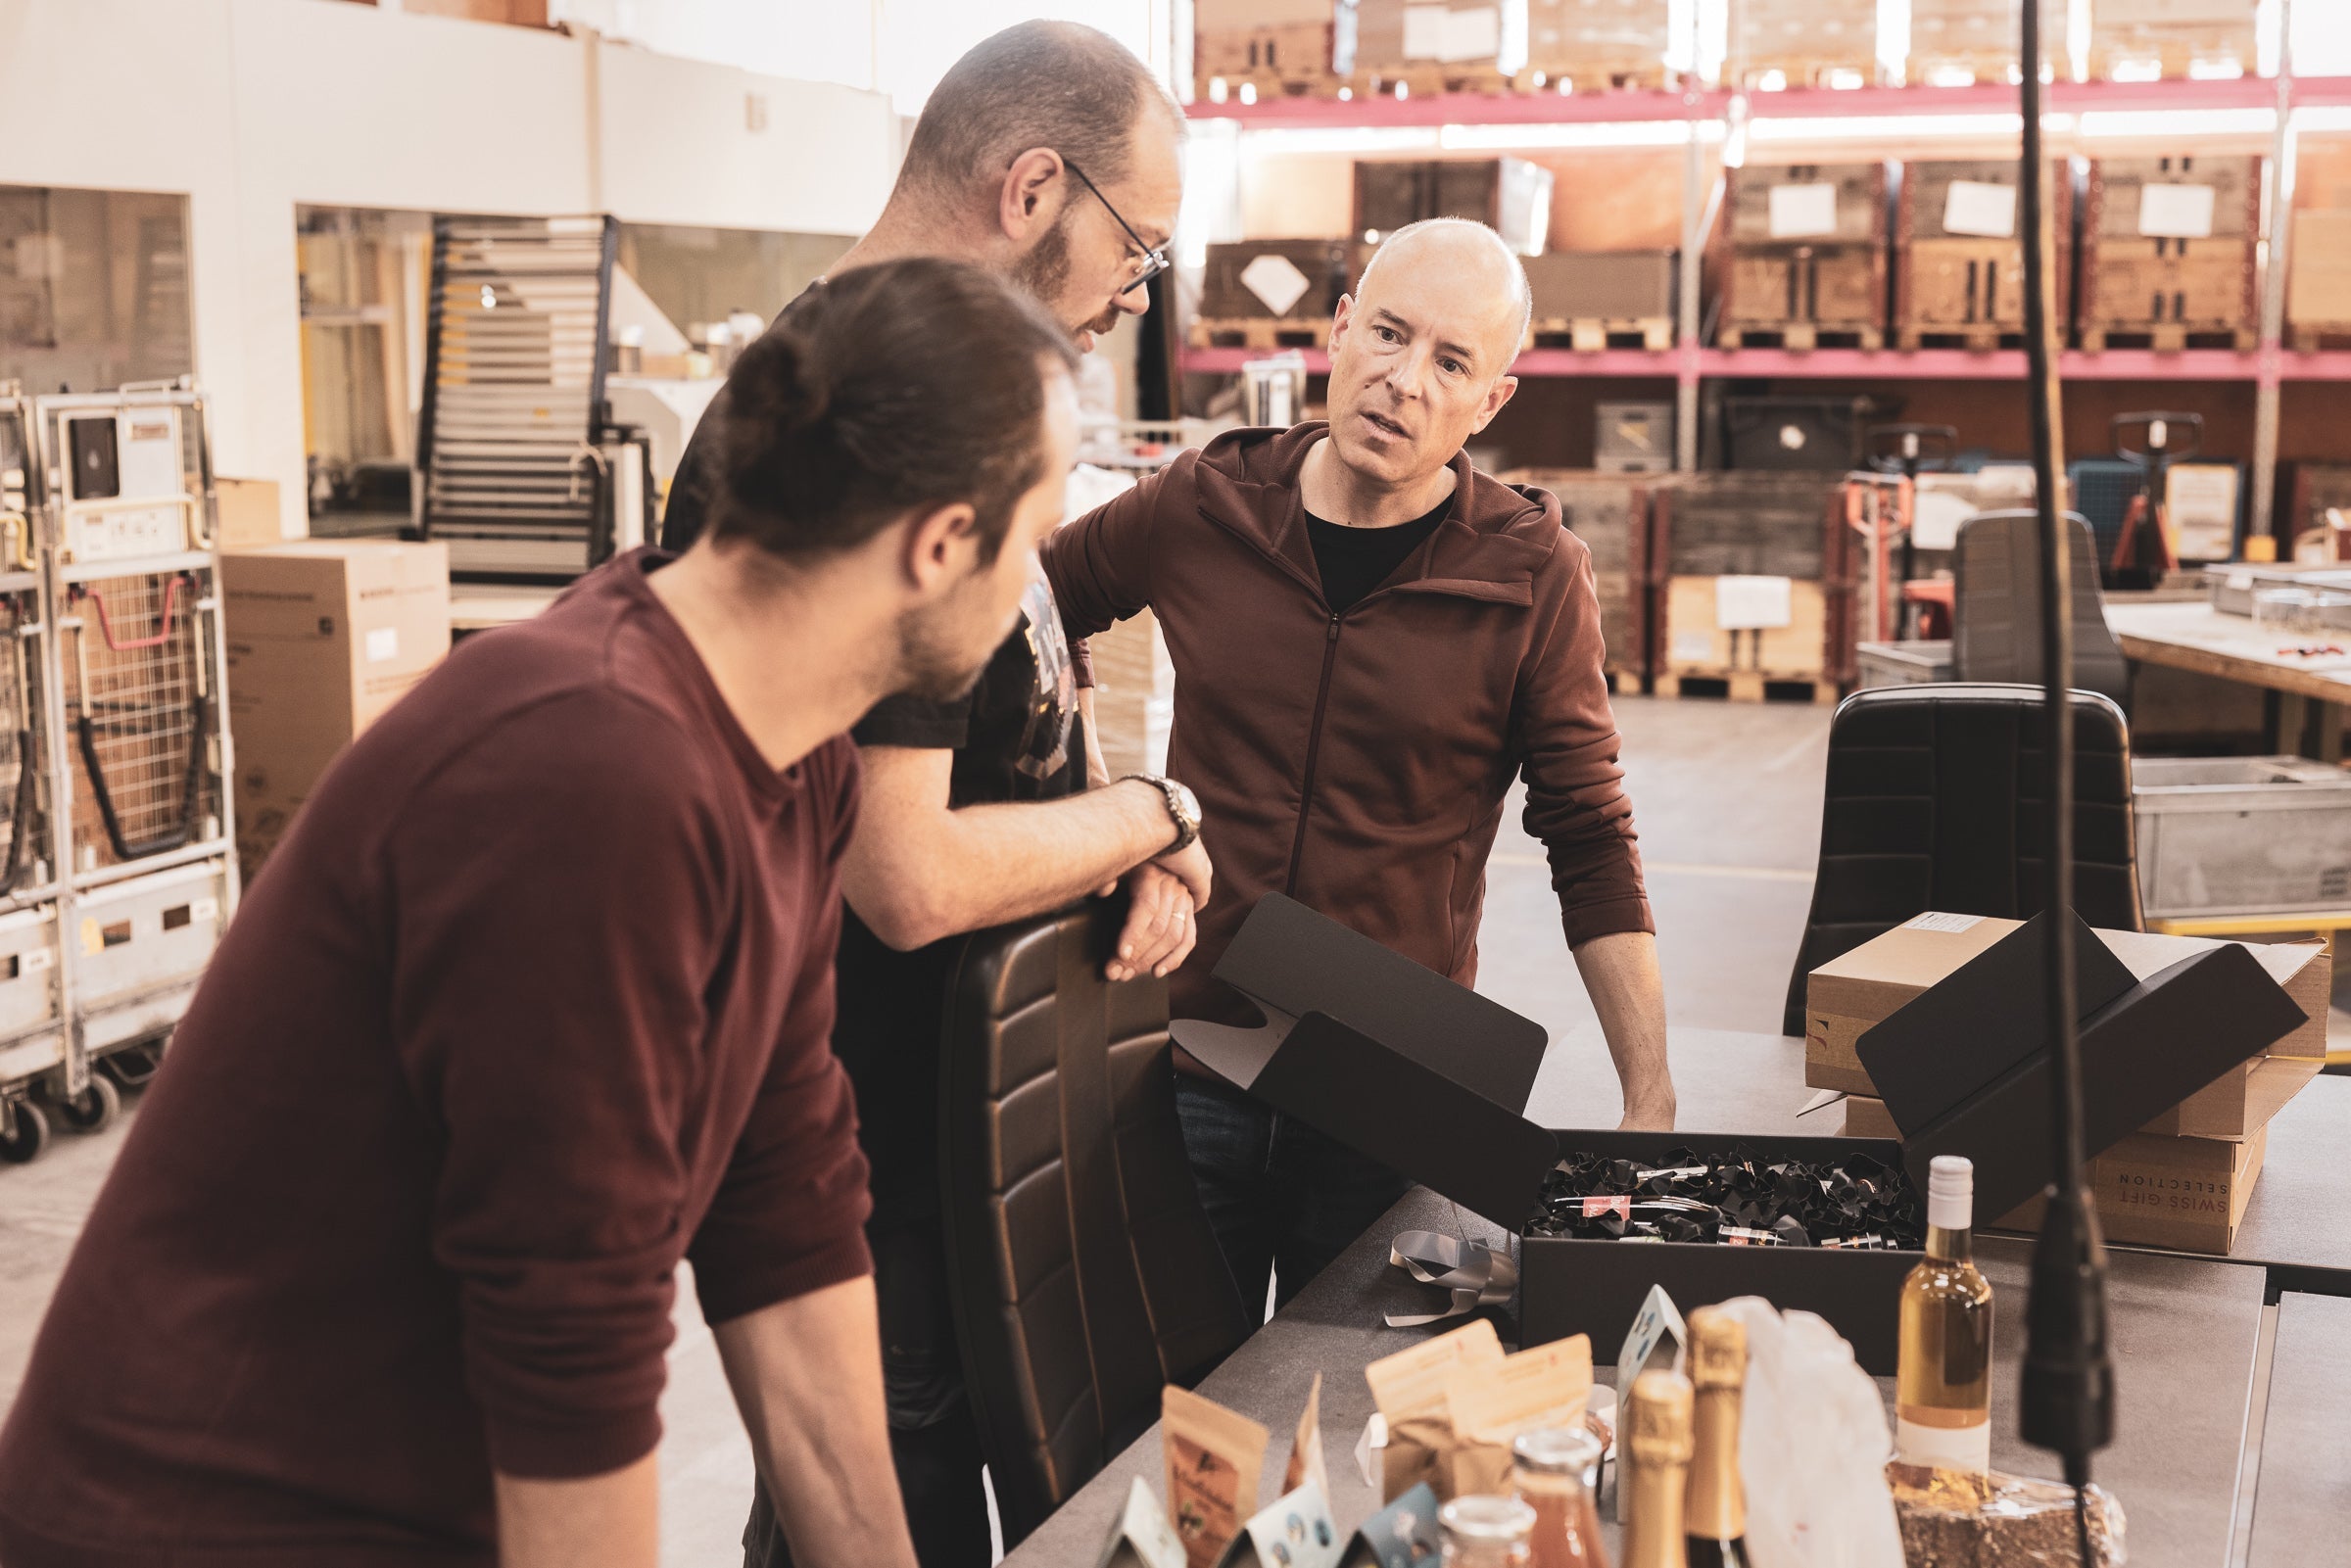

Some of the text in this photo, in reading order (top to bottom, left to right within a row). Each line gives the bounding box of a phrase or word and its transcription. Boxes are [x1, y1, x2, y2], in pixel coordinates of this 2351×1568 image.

[2120, 1174, 2228, 1194] SELECTION
[2119, 1191, 2227, 1213] SWISS GIFT
